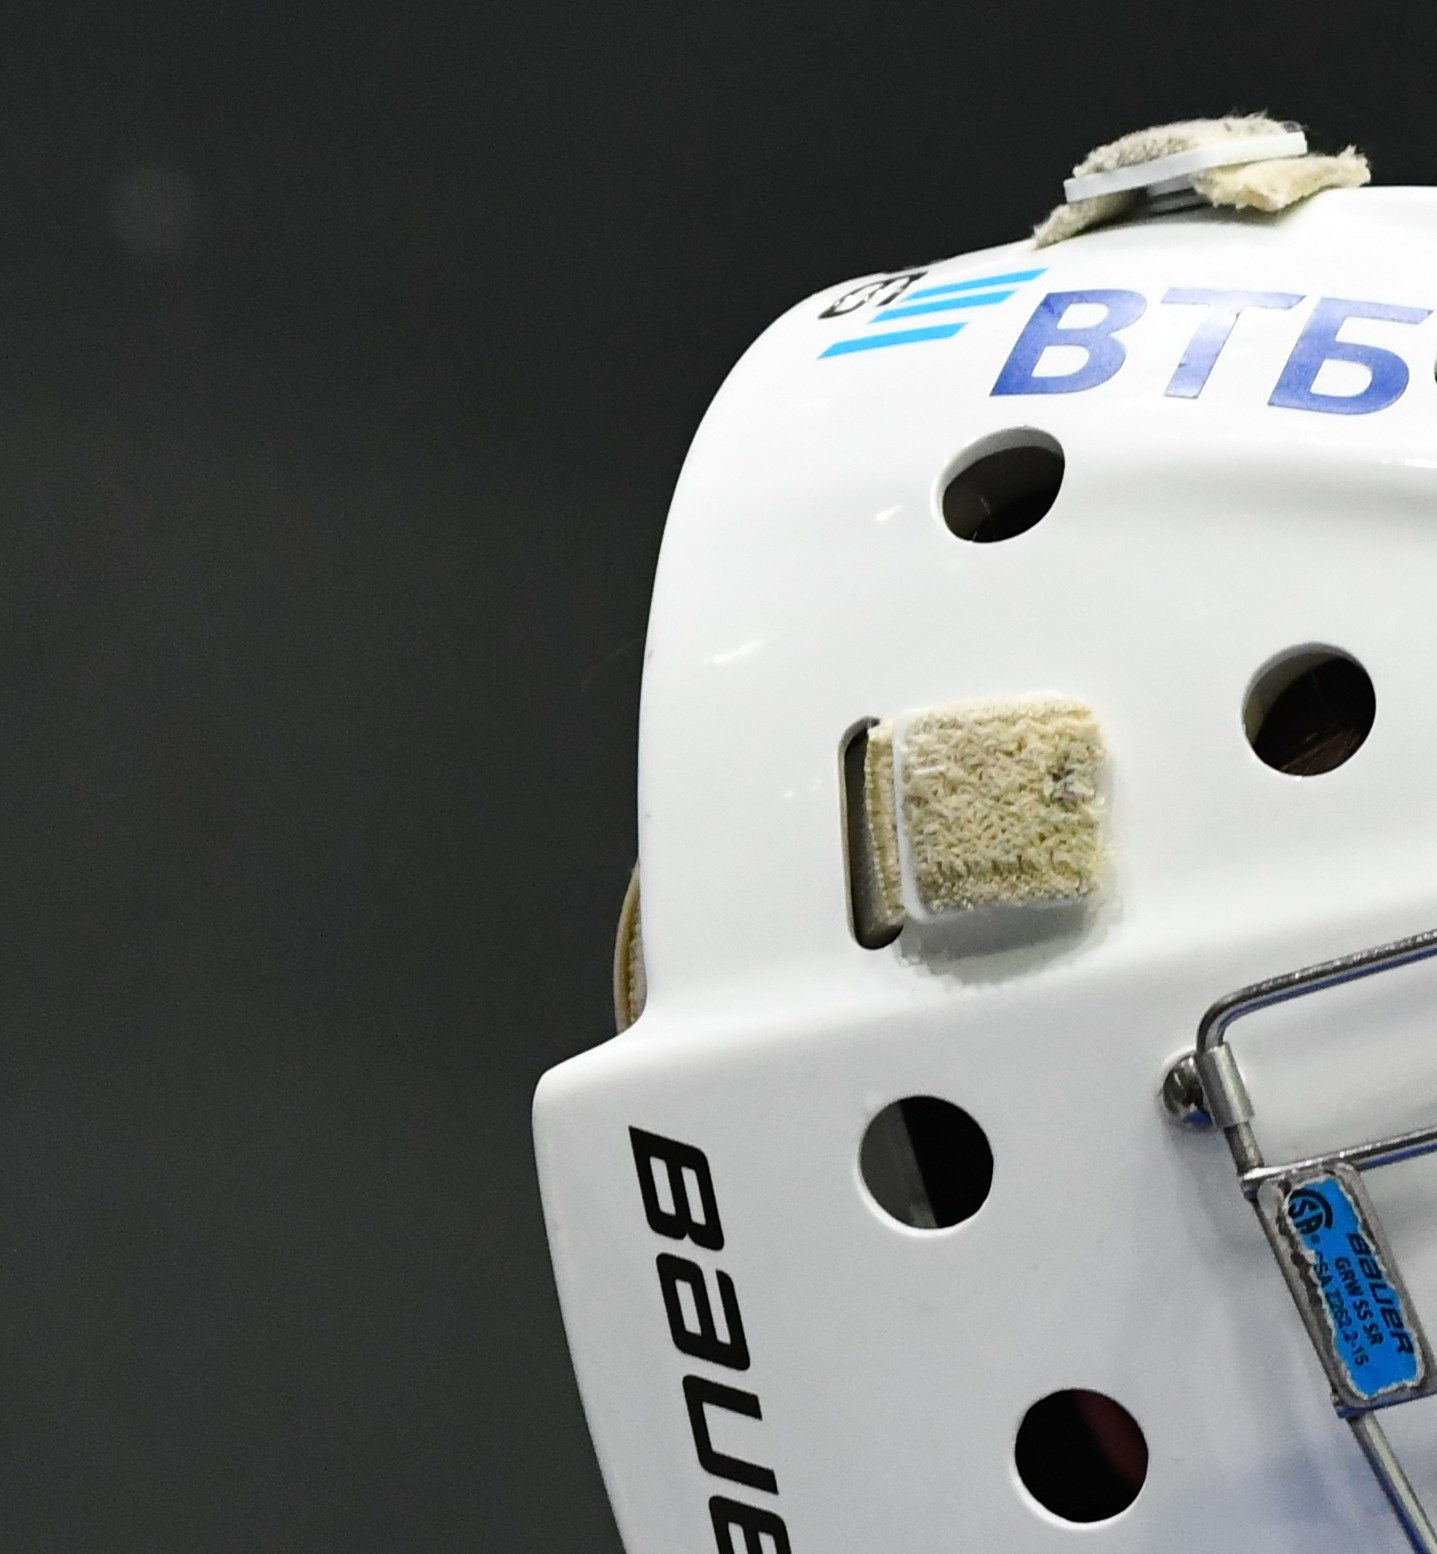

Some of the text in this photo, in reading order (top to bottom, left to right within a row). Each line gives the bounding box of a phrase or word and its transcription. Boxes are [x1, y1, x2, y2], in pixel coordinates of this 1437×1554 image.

[990, 286, 1434, 415] ВТБ
[1335, 1257, 1385, 1346] GRW SS SR
